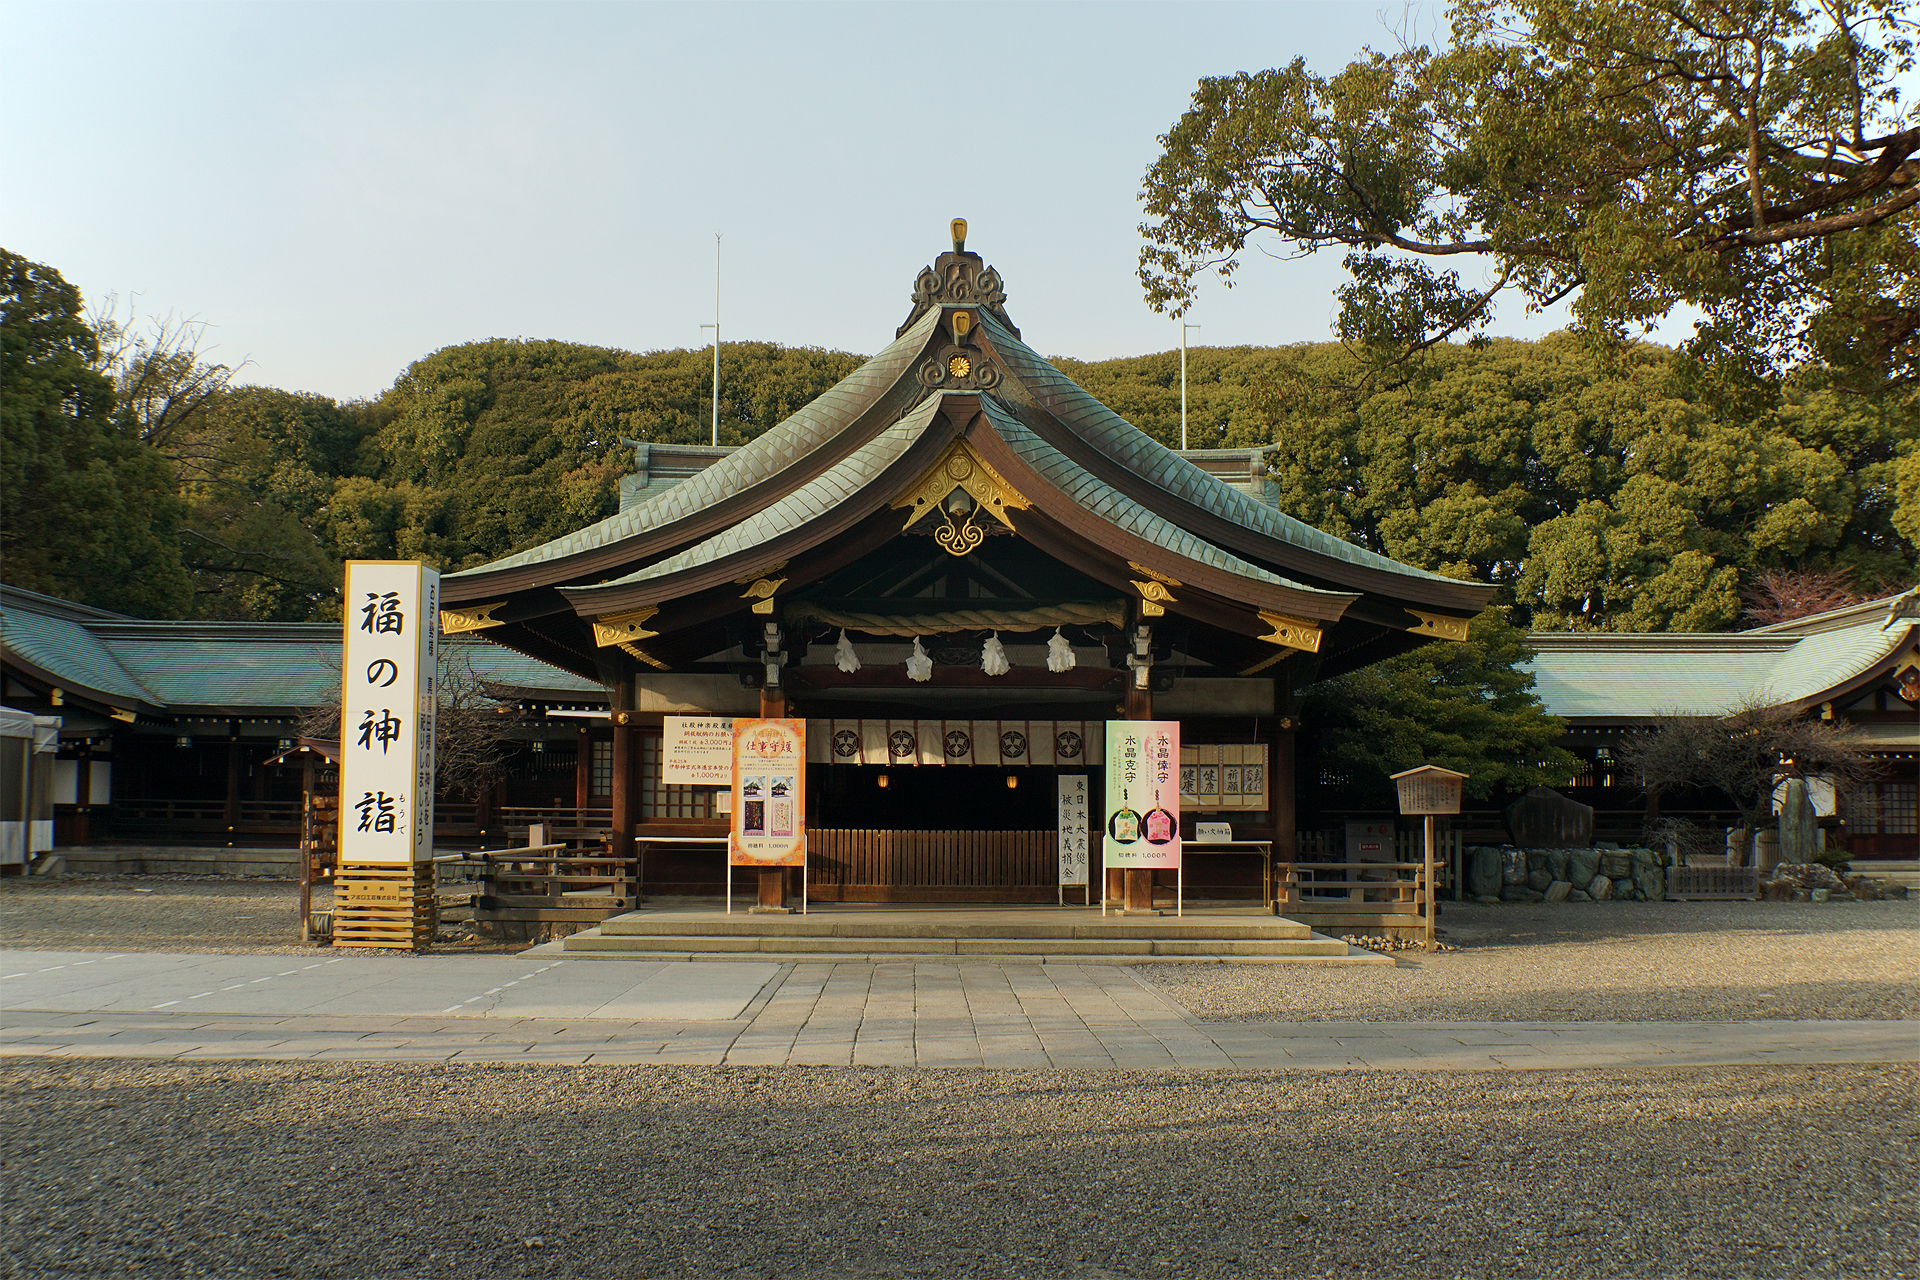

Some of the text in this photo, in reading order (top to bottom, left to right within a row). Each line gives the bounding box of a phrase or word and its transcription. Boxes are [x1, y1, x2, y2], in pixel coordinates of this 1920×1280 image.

[354, 591, 405, 834] 福の神詣
[745, 741, 792, 753] 仕事守護
[1125, 735, 1136, 783] 水晶克守
[1157, 735, 1169, 783] 水晶倖守
[1181, 769, 1195, 793] 健康
[1203, 769, 1217, 793] 健康
[1226, 769, 1239, 792] 祈願
[397, 793, 407, 835] もうで
[1062, 794, 1073, 878] 被災地義捐金
[1076, 780, 1087, 864] 東日本大震災
